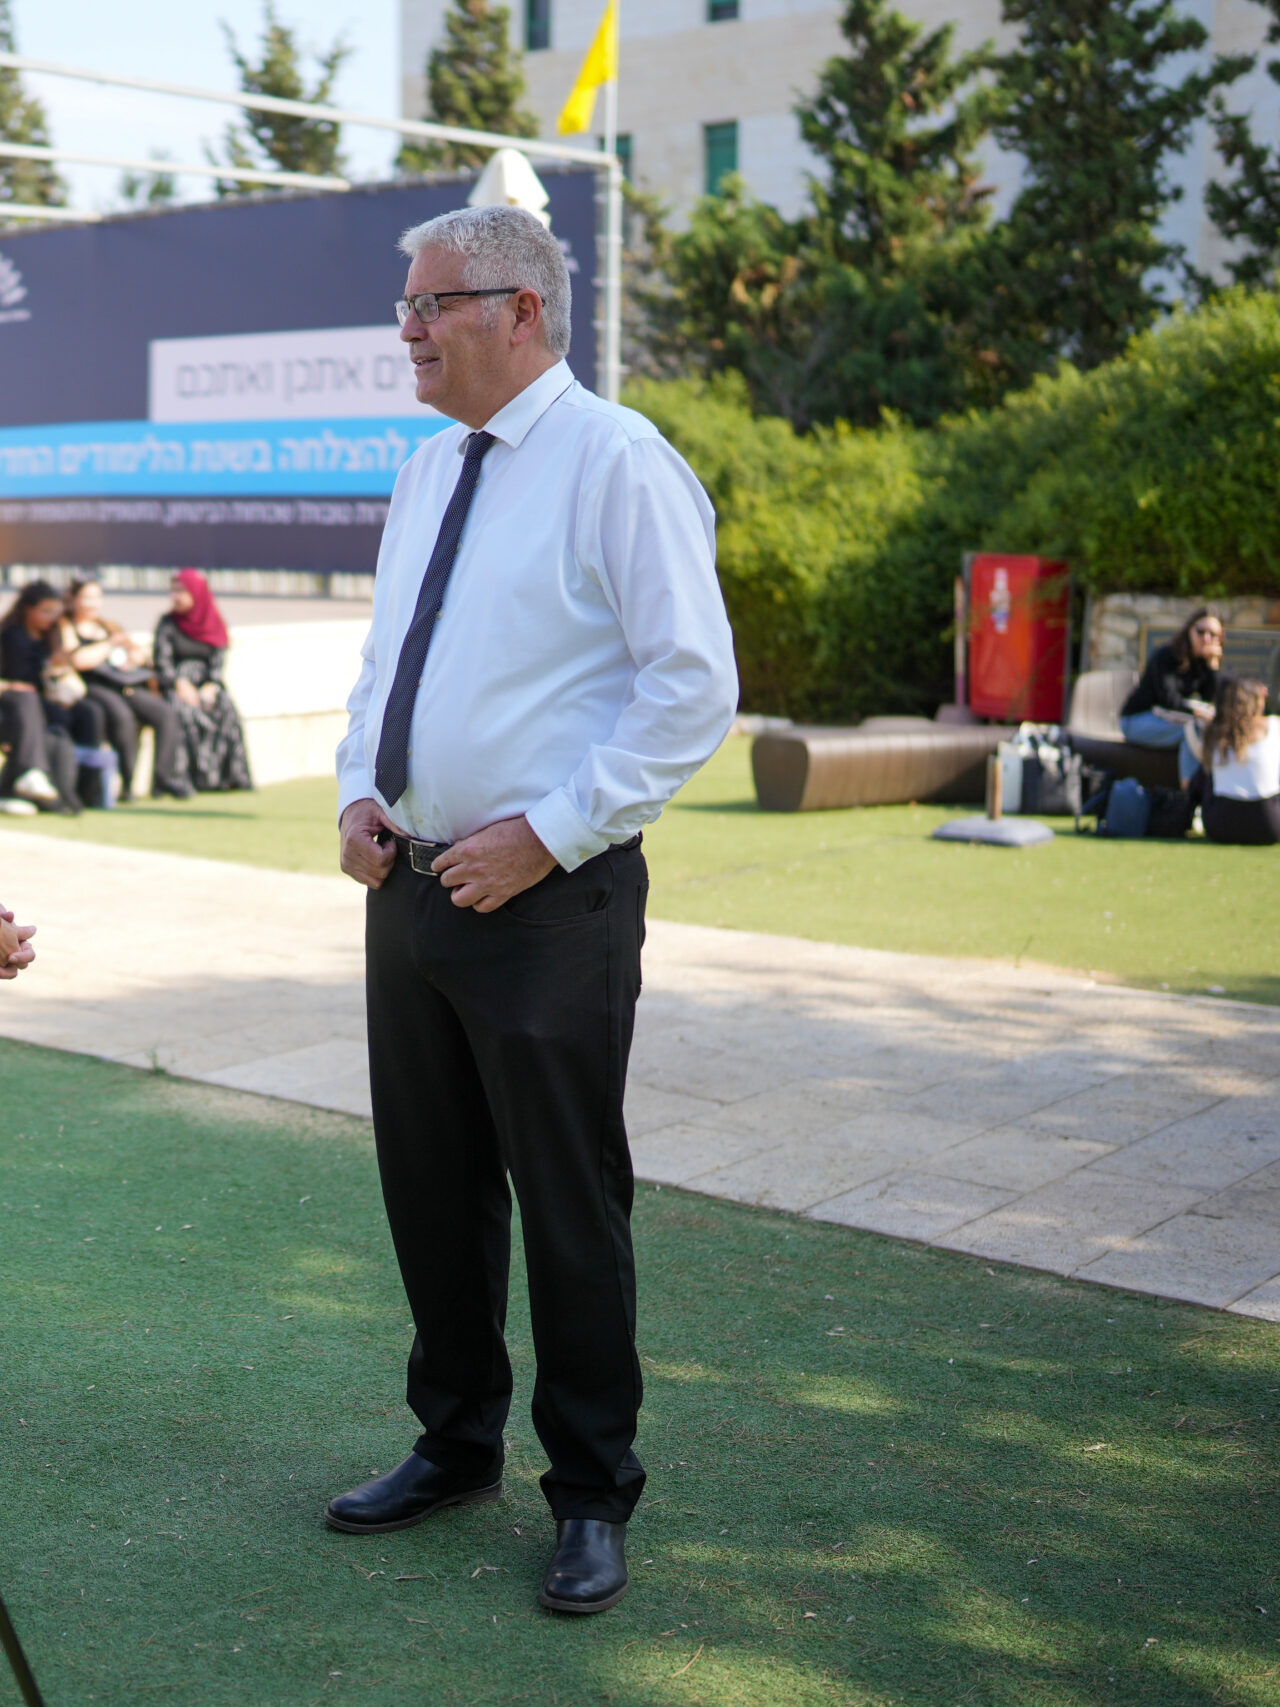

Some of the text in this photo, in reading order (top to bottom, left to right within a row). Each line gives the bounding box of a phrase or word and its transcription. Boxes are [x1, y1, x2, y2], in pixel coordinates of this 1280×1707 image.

[176, 358, 275, 400] ואתכם
[282, 356, 364, 404] אתכן
[58, 434, 186, 475] הלימודים
[190, 439, 272, 473] בשנת
[278, 428, 409, 471] להצלחה
